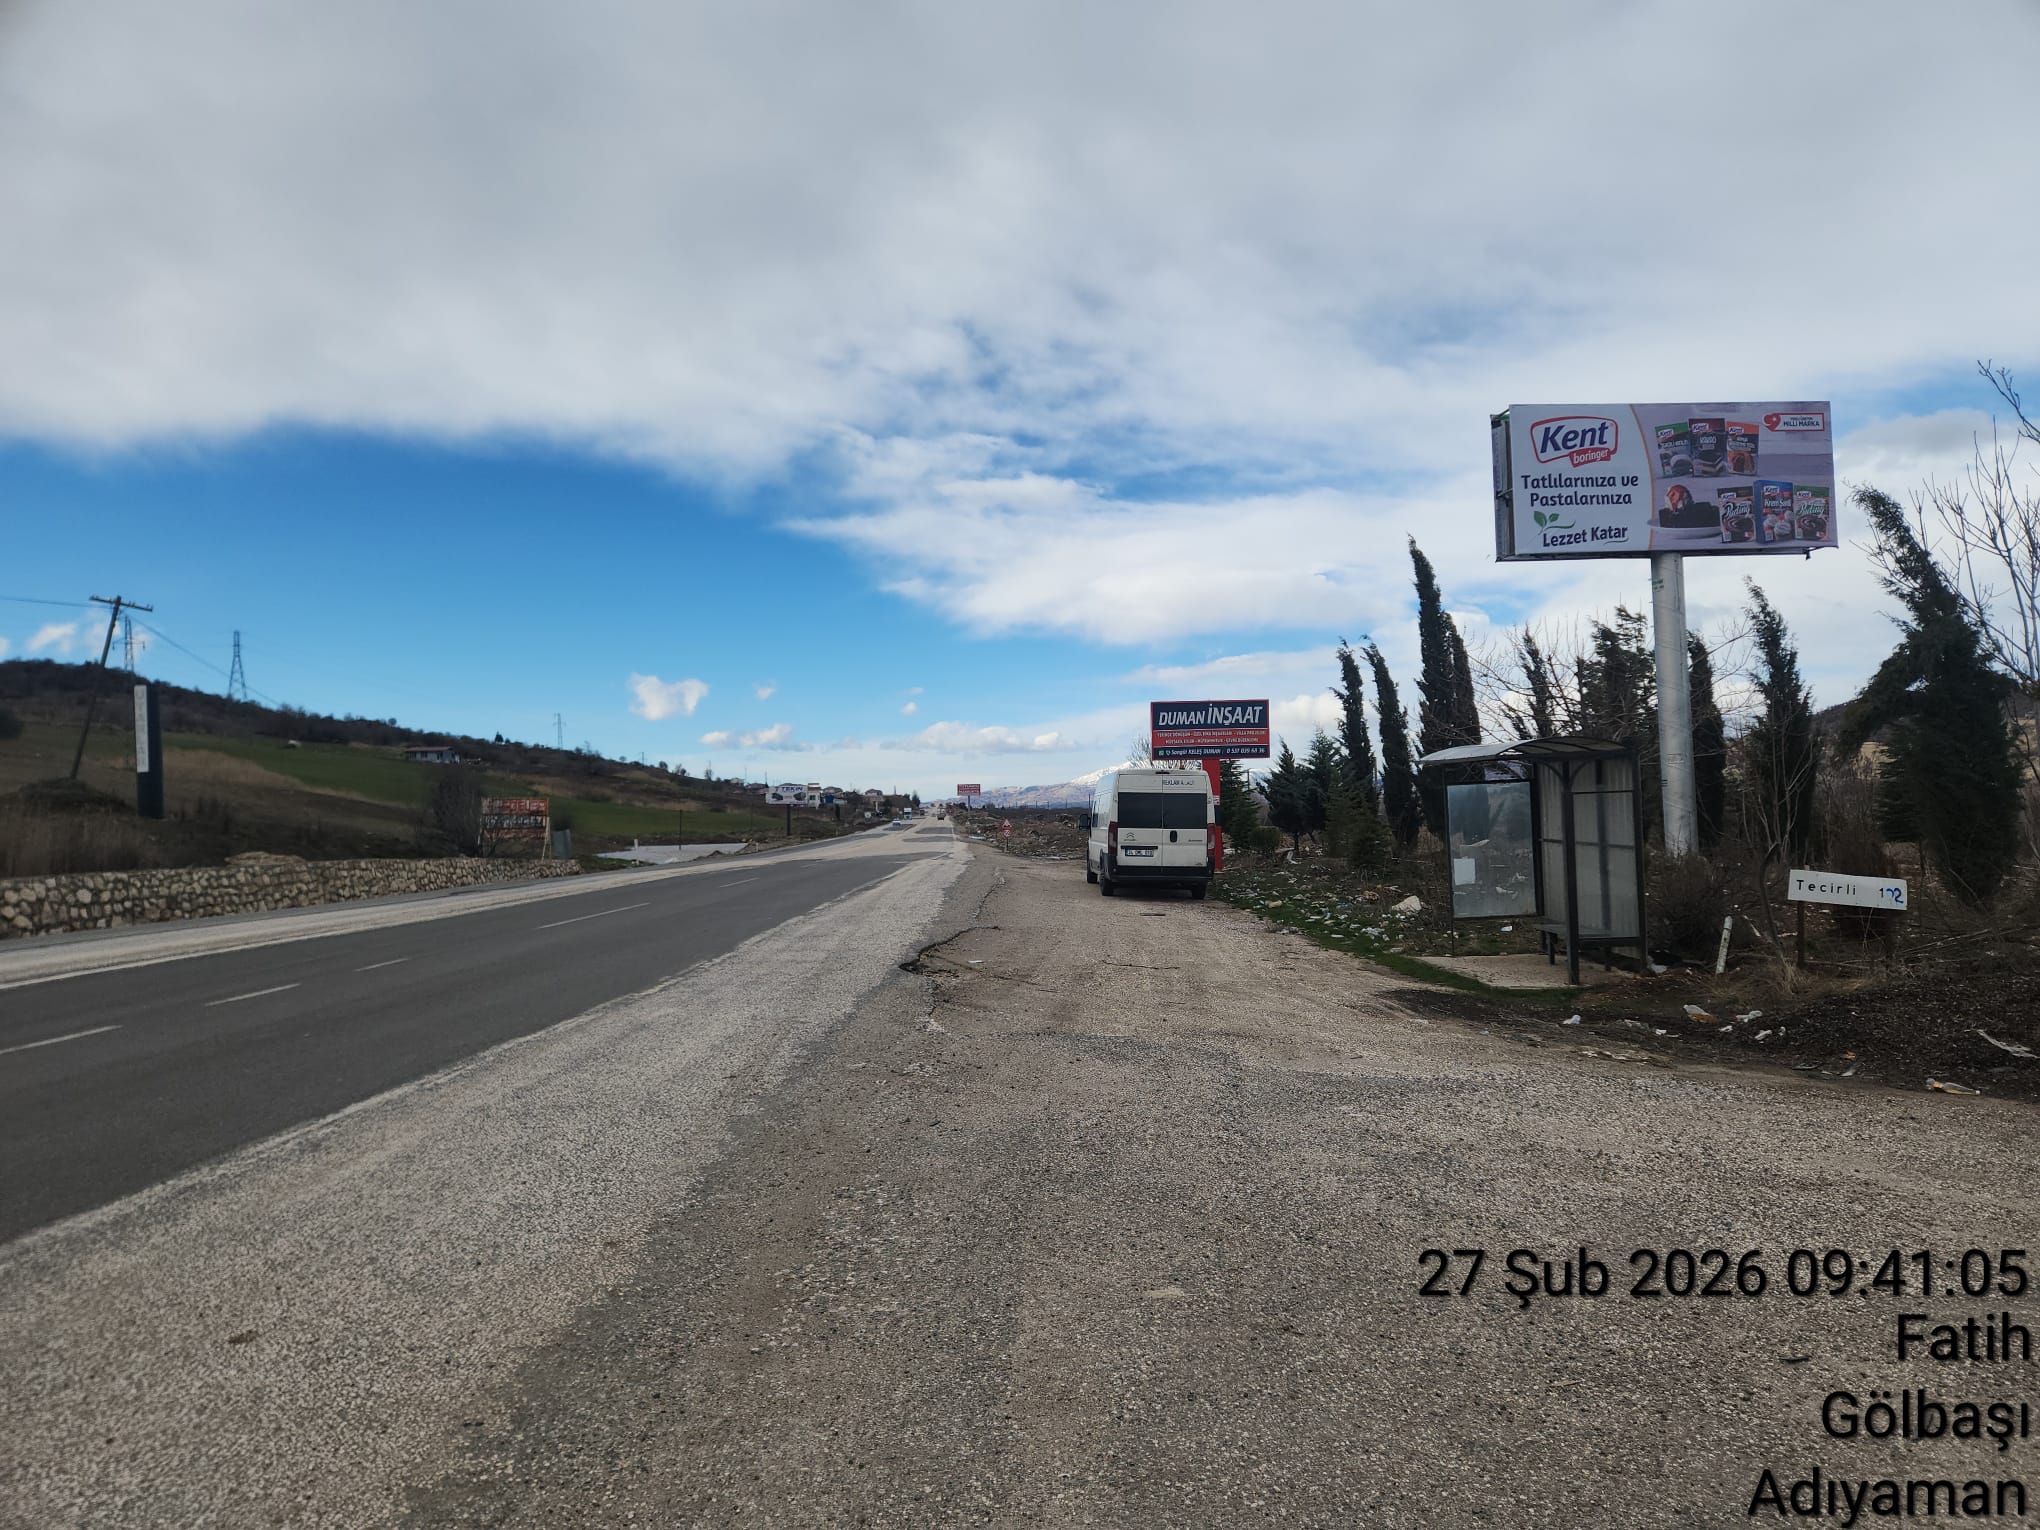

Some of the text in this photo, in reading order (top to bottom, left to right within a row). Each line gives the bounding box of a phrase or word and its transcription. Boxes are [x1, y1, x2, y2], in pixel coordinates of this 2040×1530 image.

[1540, 421, 1609, 453] Kent
[1573, 449, 1609, 464] boringer
[1521, 473, 1639, 489] Tatlılarınıza ve
[1530, 490, 1632, 507] Pastalarınıza
[1543, 525, 1628, 547] Lezzet Katar
[1158, 703, 1263, 726] DUMAN İNŞAAT
[1796, 879, 1856, 895] Tecirli
